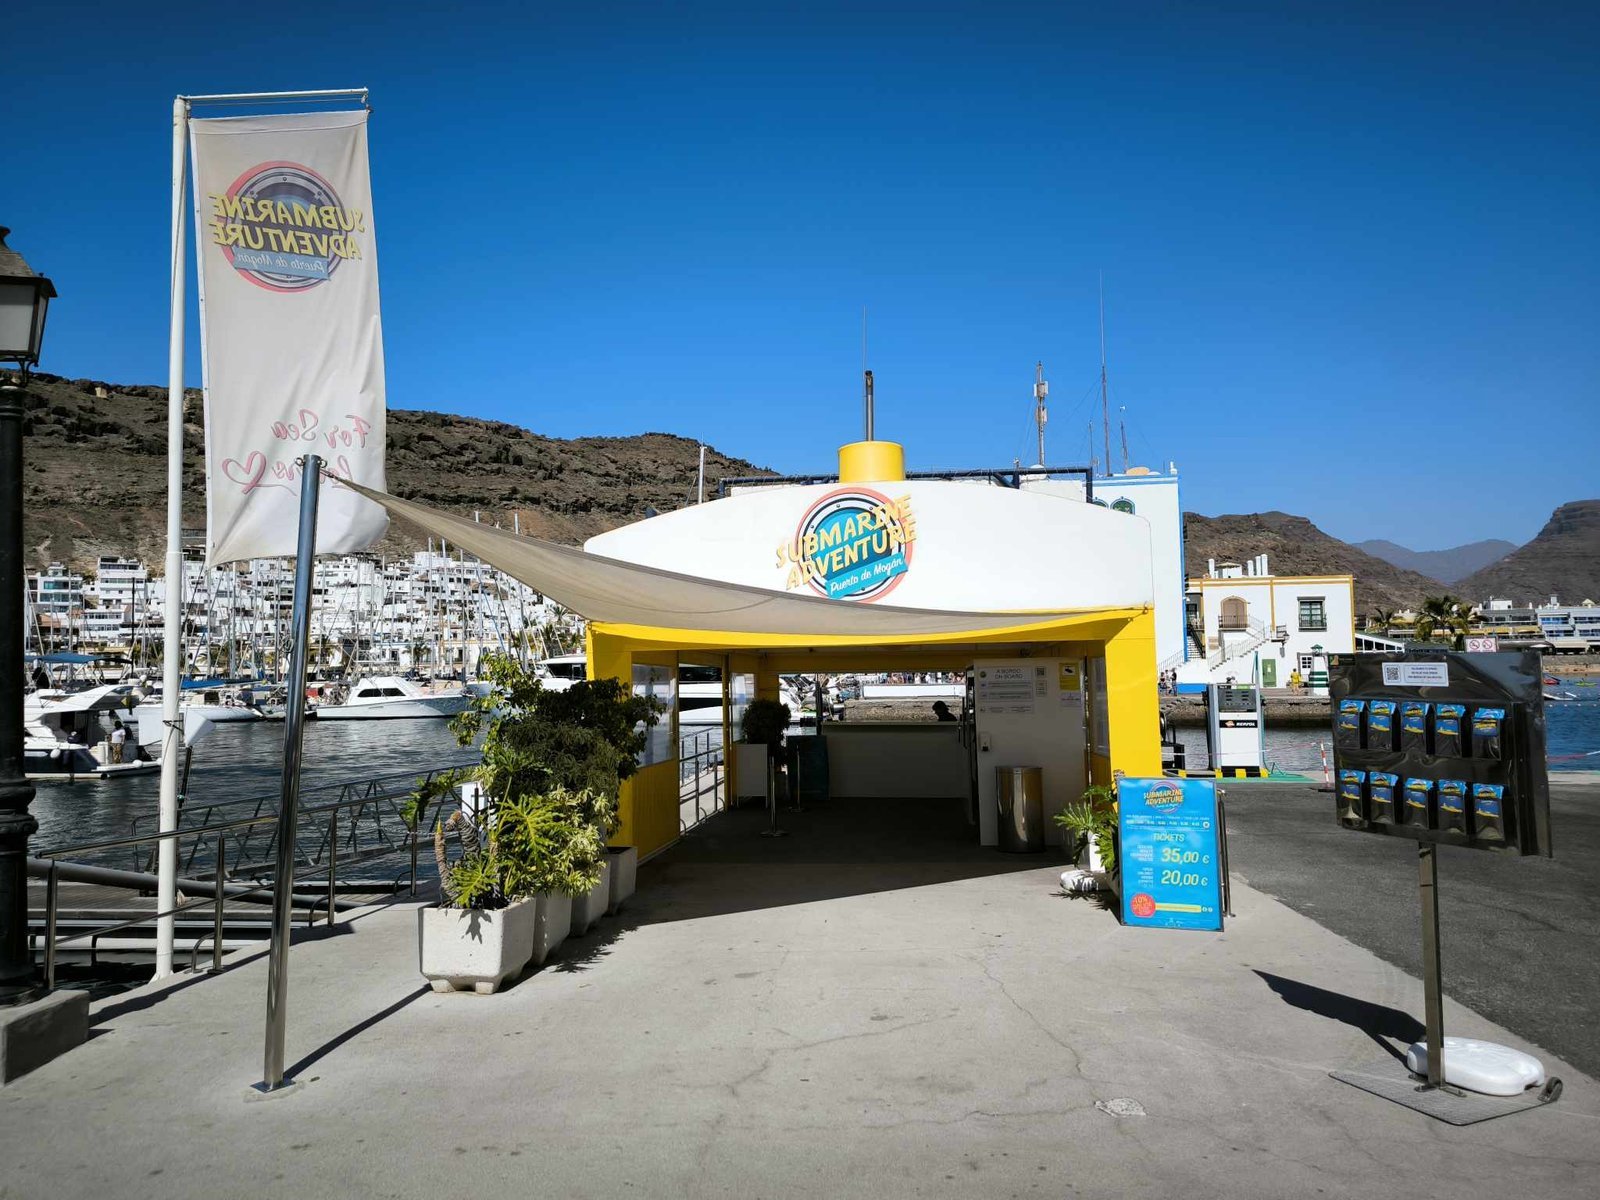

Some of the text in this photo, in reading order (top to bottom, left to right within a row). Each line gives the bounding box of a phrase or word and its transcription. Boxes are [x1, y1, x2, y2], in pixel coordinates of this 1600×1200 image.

[776, 494, 911, 569] SUBMARINE
[786, 518, 917, 590] ADVENTURE
[830, 556, 904, 595] Puerto de Mogán
[1143, 788, 1184, 799] SUBMARINE
[1145, 795, 1184, 806] ADVENTURE
[1153, 832, 1185, 842] TICKETS
[1161, 847, 1199, 865] 35,00
[1202, 855, 1209, 864] €
[1161, 870, 1199, 886] 20,00
[1201, 877, 1208, 886] €
